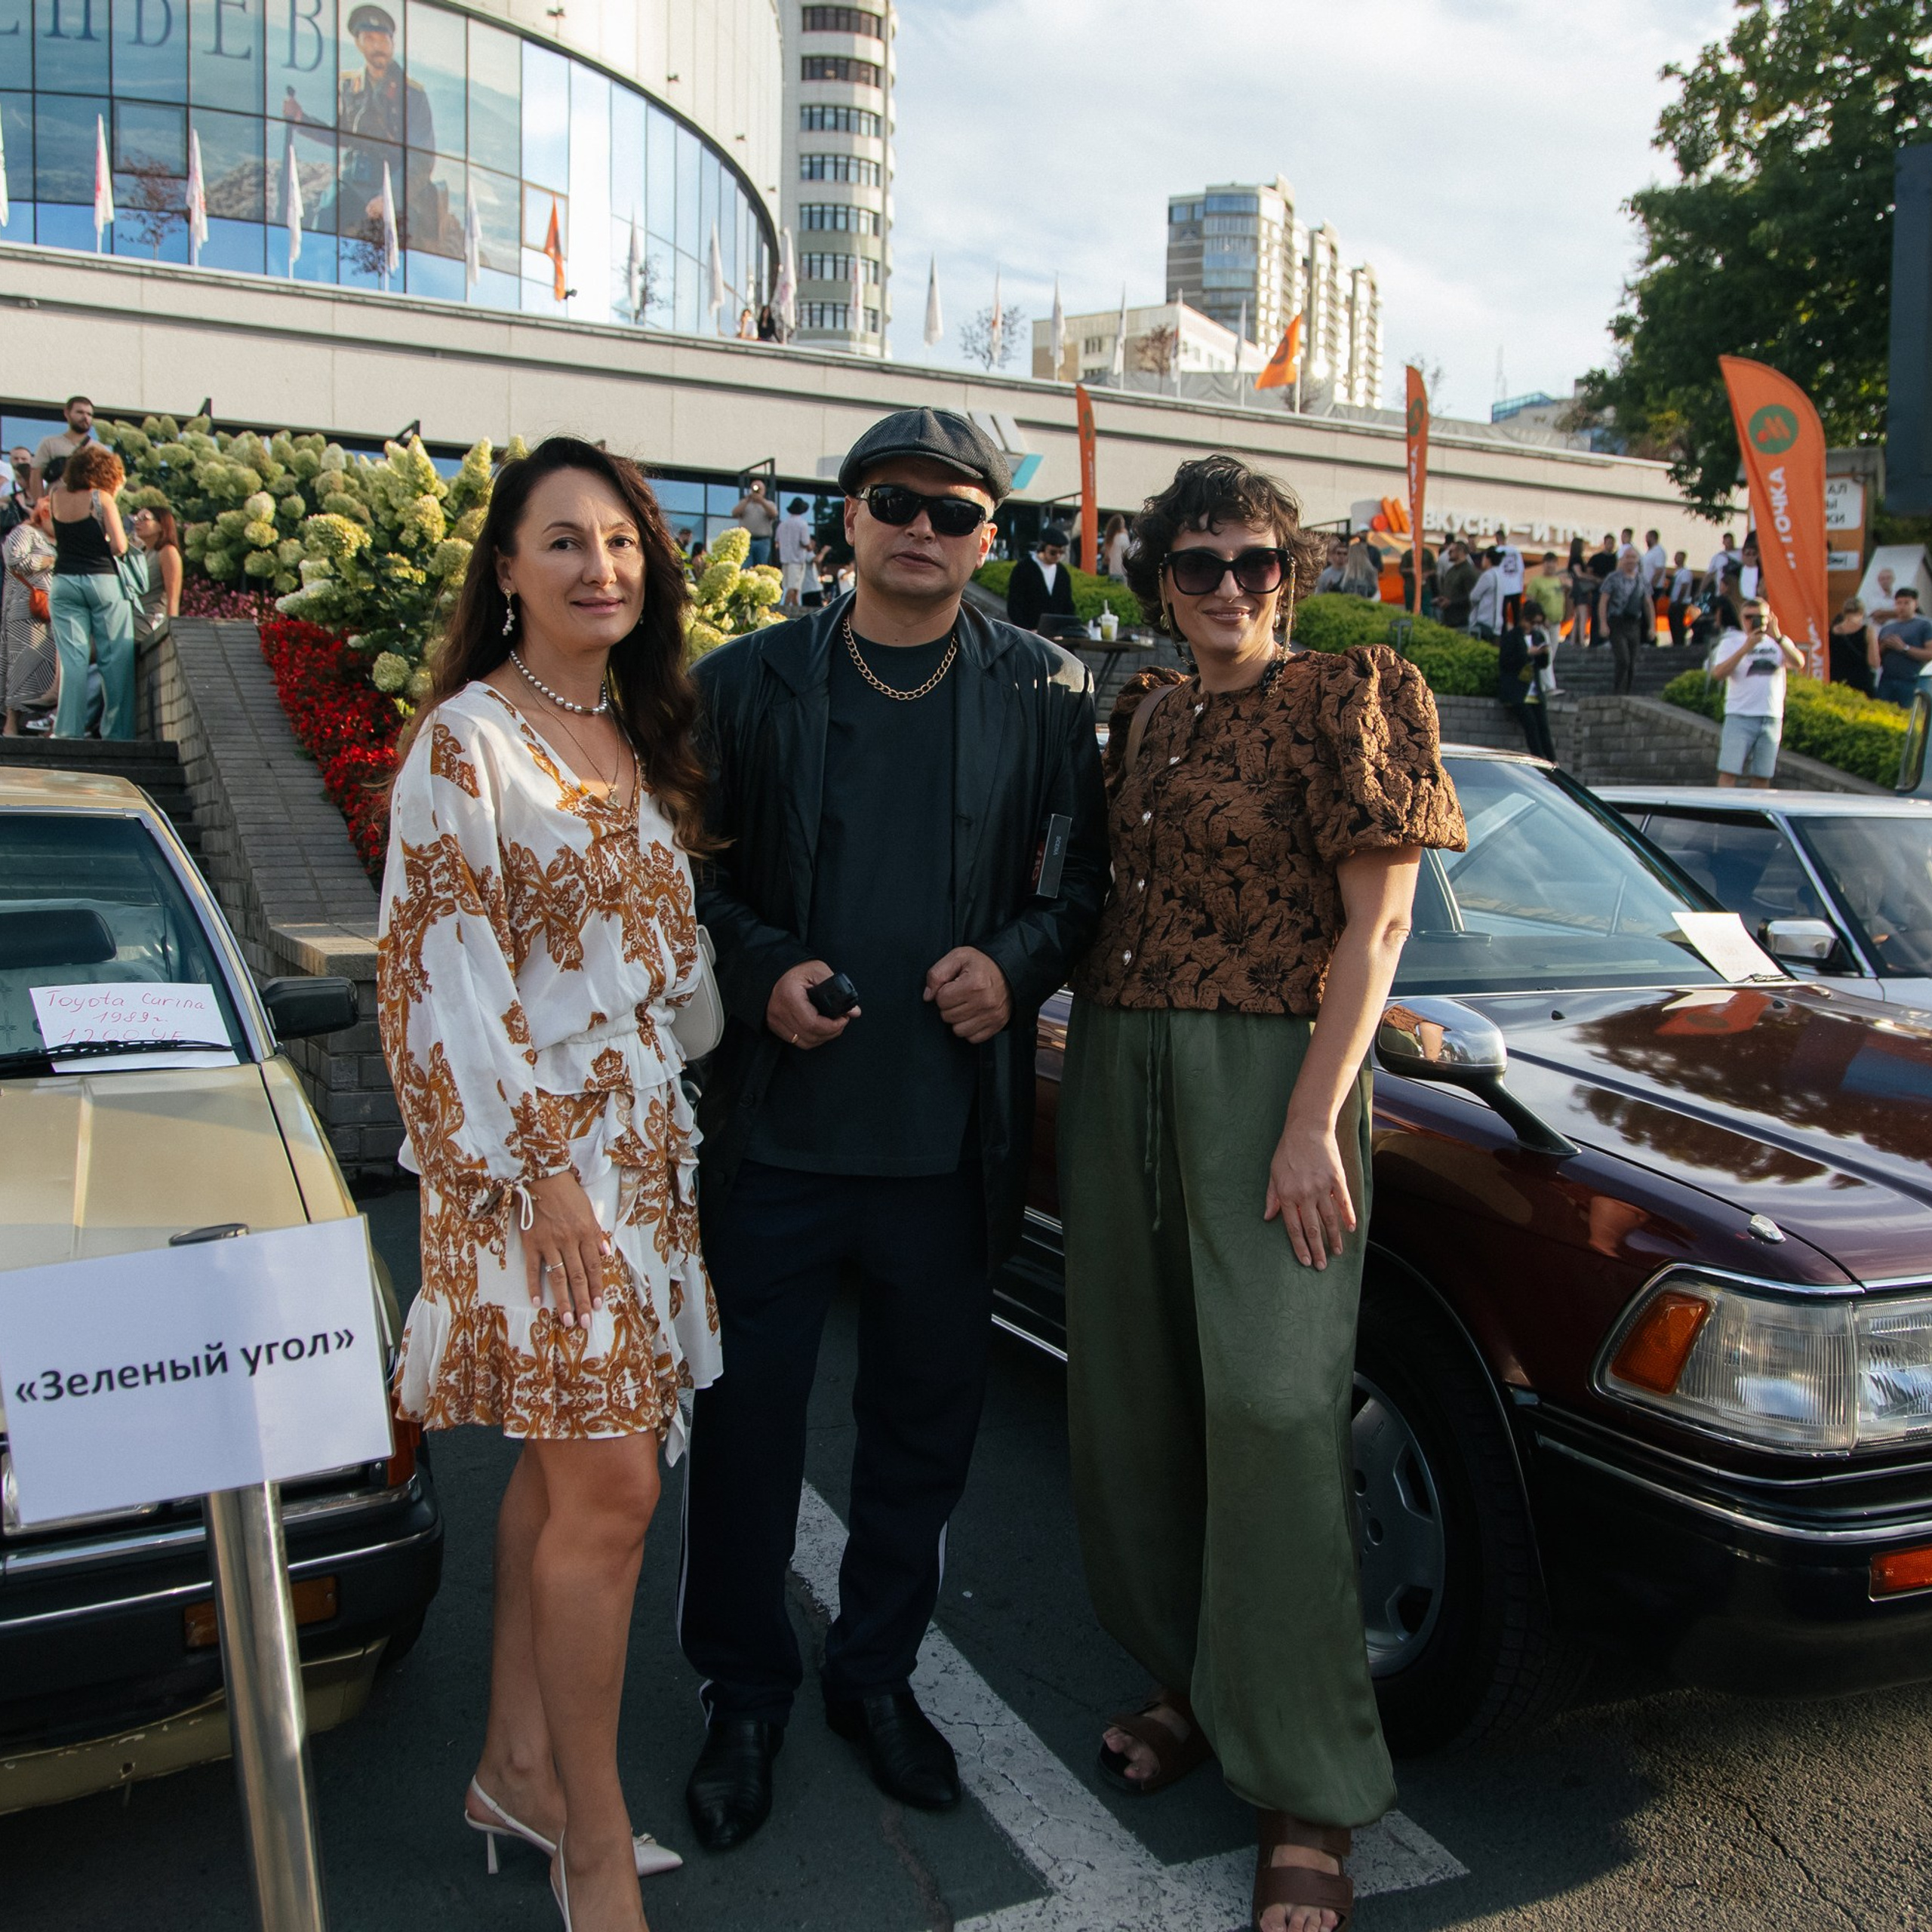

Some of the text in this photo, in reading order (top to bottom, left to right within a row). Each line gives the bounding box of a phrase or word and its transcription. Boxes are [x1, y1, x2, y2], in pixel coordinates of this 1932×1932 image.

[46, 989, 205, 1013] Toyota Carina
[15, 1327, 355, 1404] «Зеленый угол»
